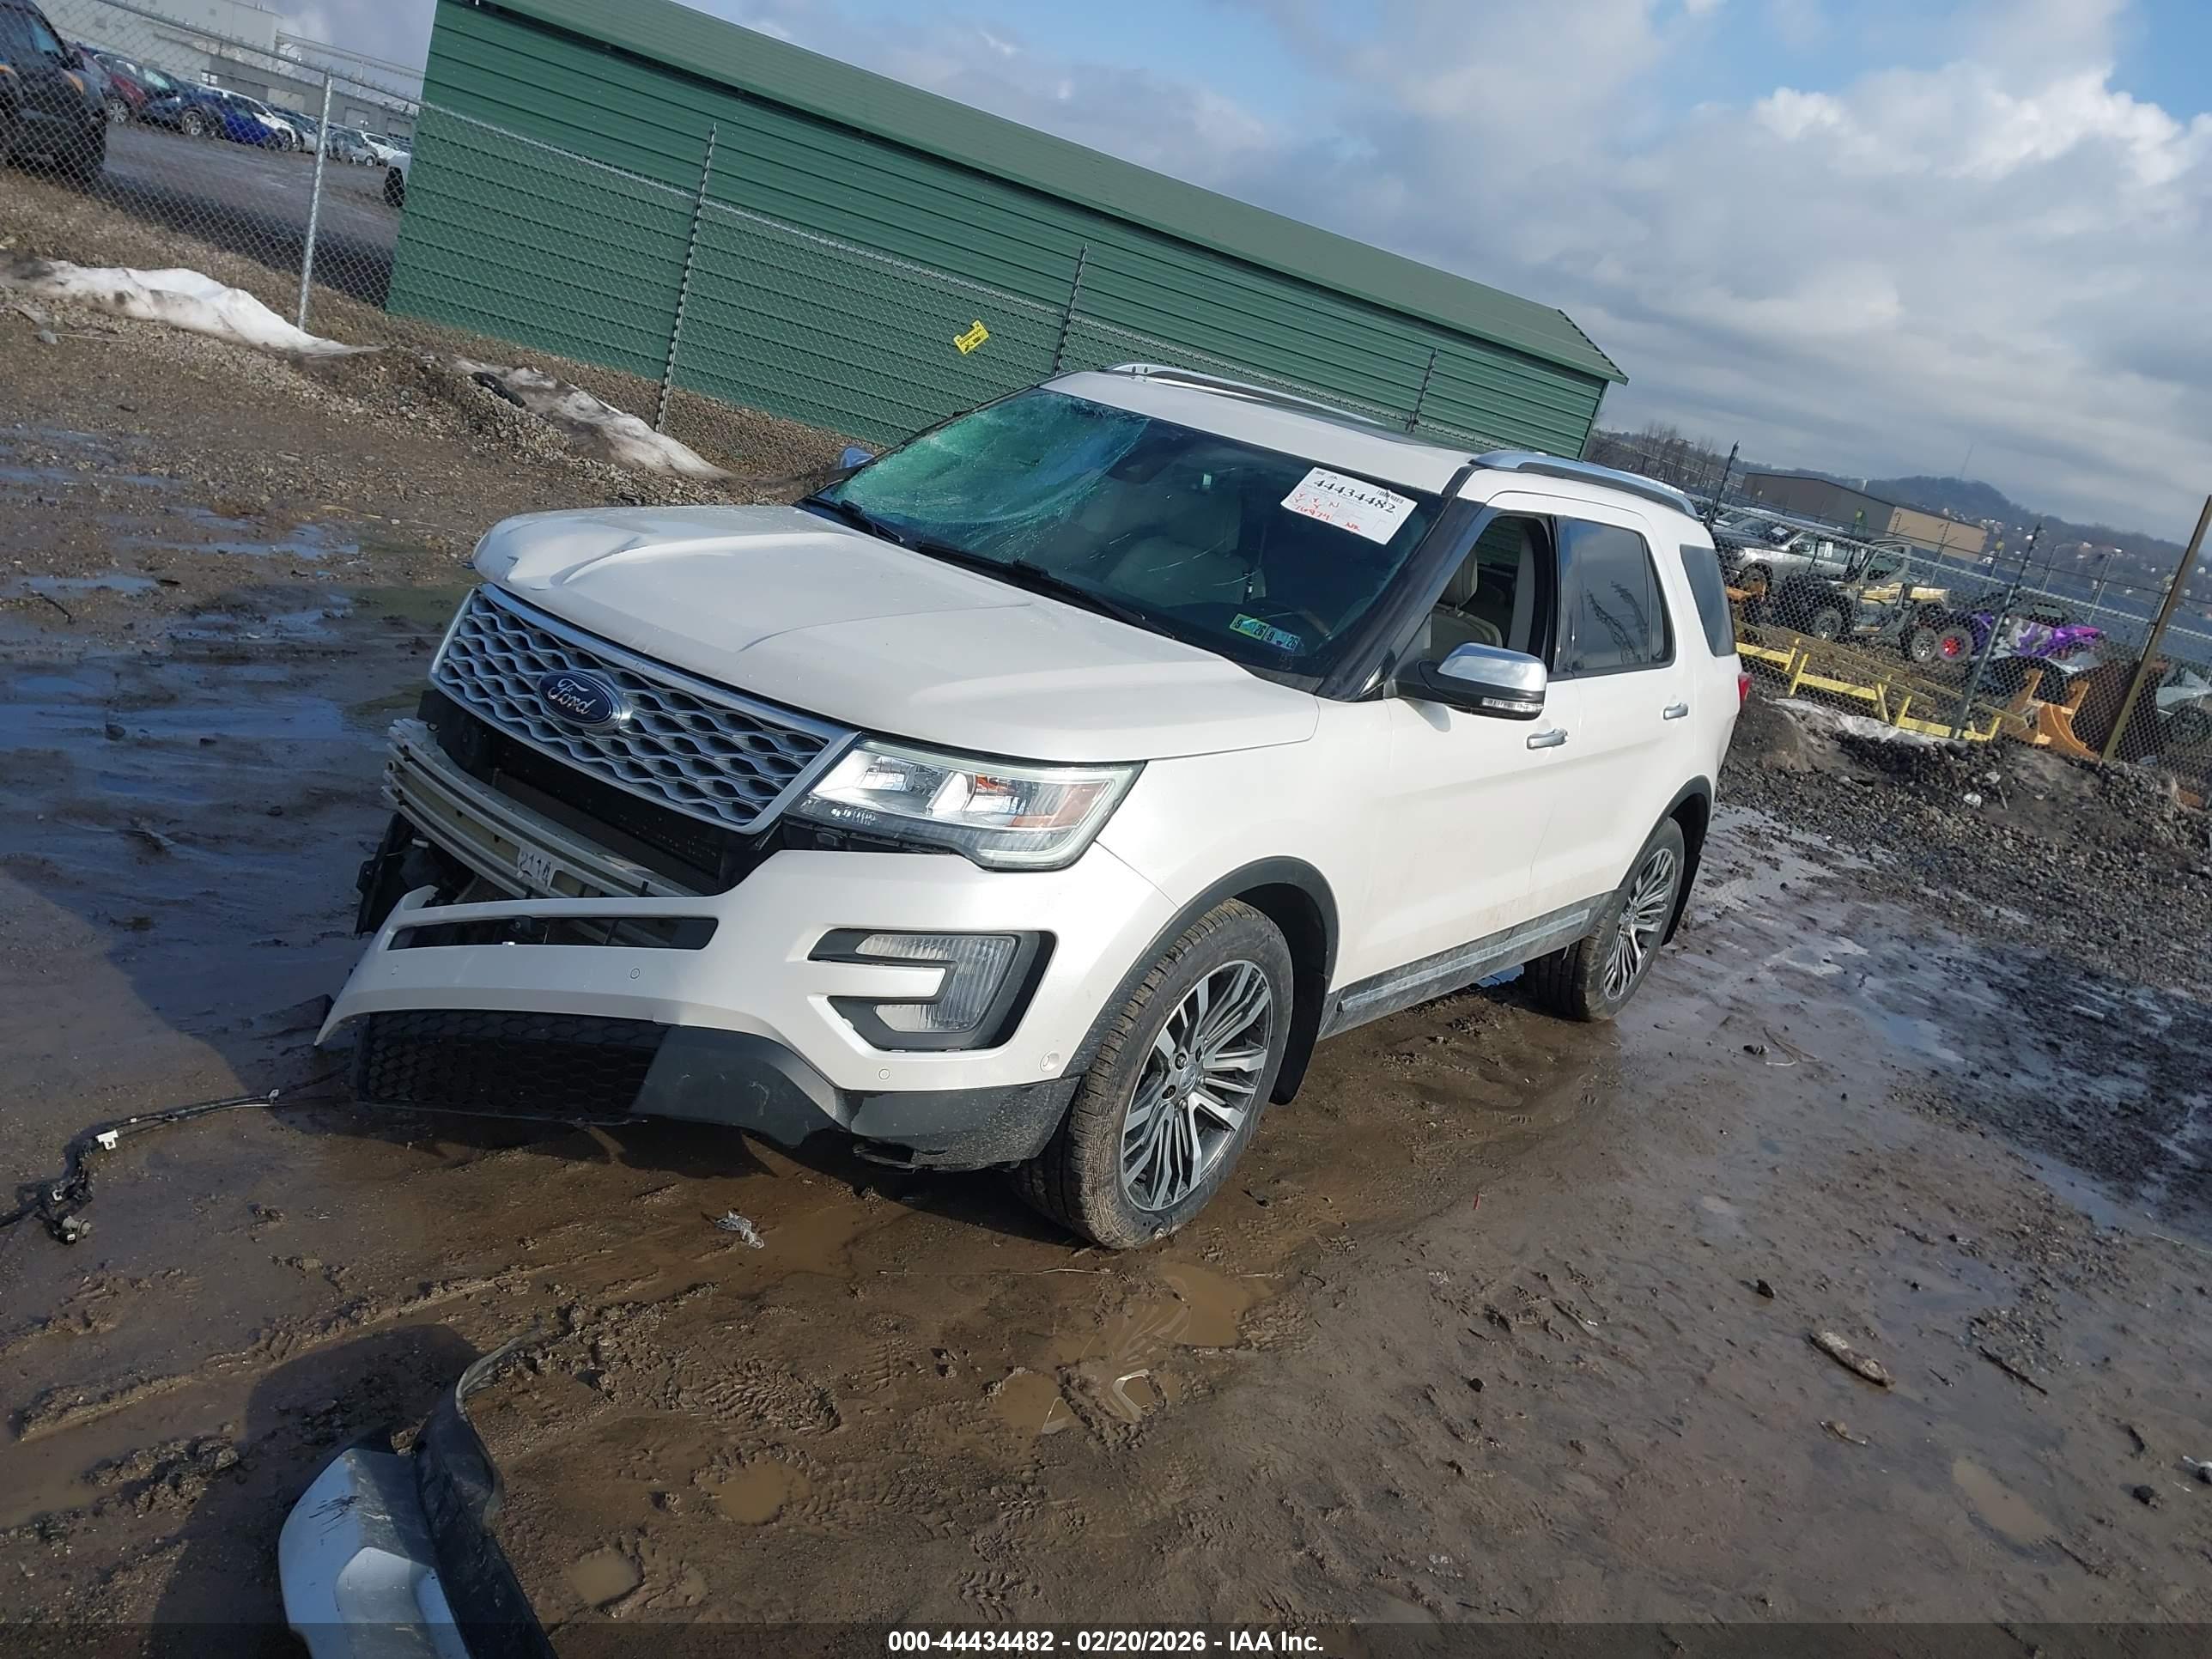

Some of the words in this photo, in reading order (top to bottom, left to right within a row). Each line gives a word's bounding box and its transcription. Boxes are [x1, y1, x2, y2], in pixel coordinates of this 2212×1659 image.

[1314, 479, 1396, 514] 44434482
[1254, 623, 1267, 636] 26
[1286, 635, 1299, 648] 26
[547, 678, 599, 715] Ford
